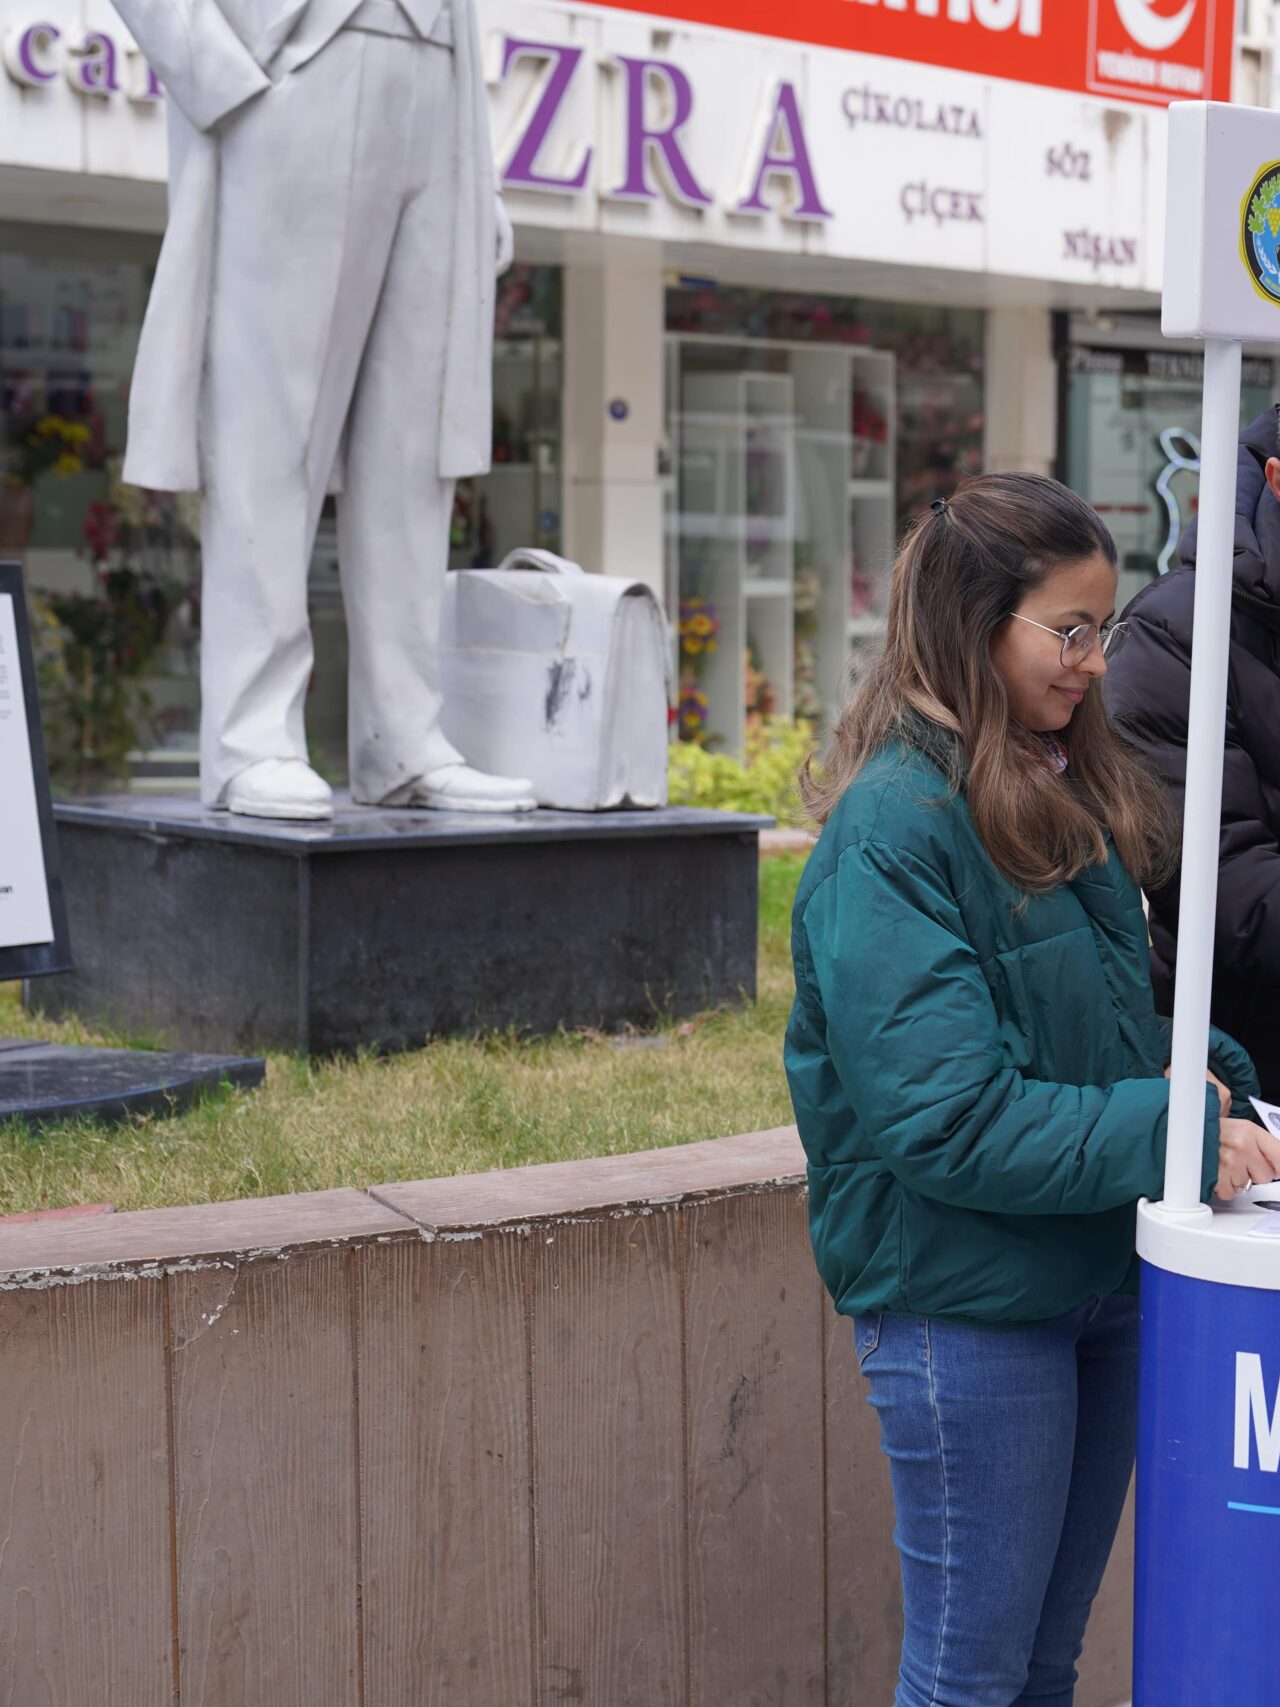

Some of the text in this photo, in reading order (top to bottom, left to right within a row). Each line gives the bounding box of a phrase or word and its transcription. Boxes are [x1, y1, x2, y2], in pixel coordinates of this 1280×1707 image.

[841, 83, 983, 140] ÇİKOLATA
[1046, 142, 1093, 183] SÖZ
[900, 180, 984, 225] ÇİÇEK
[1063, 230, 1138, 272] NİŞAN
